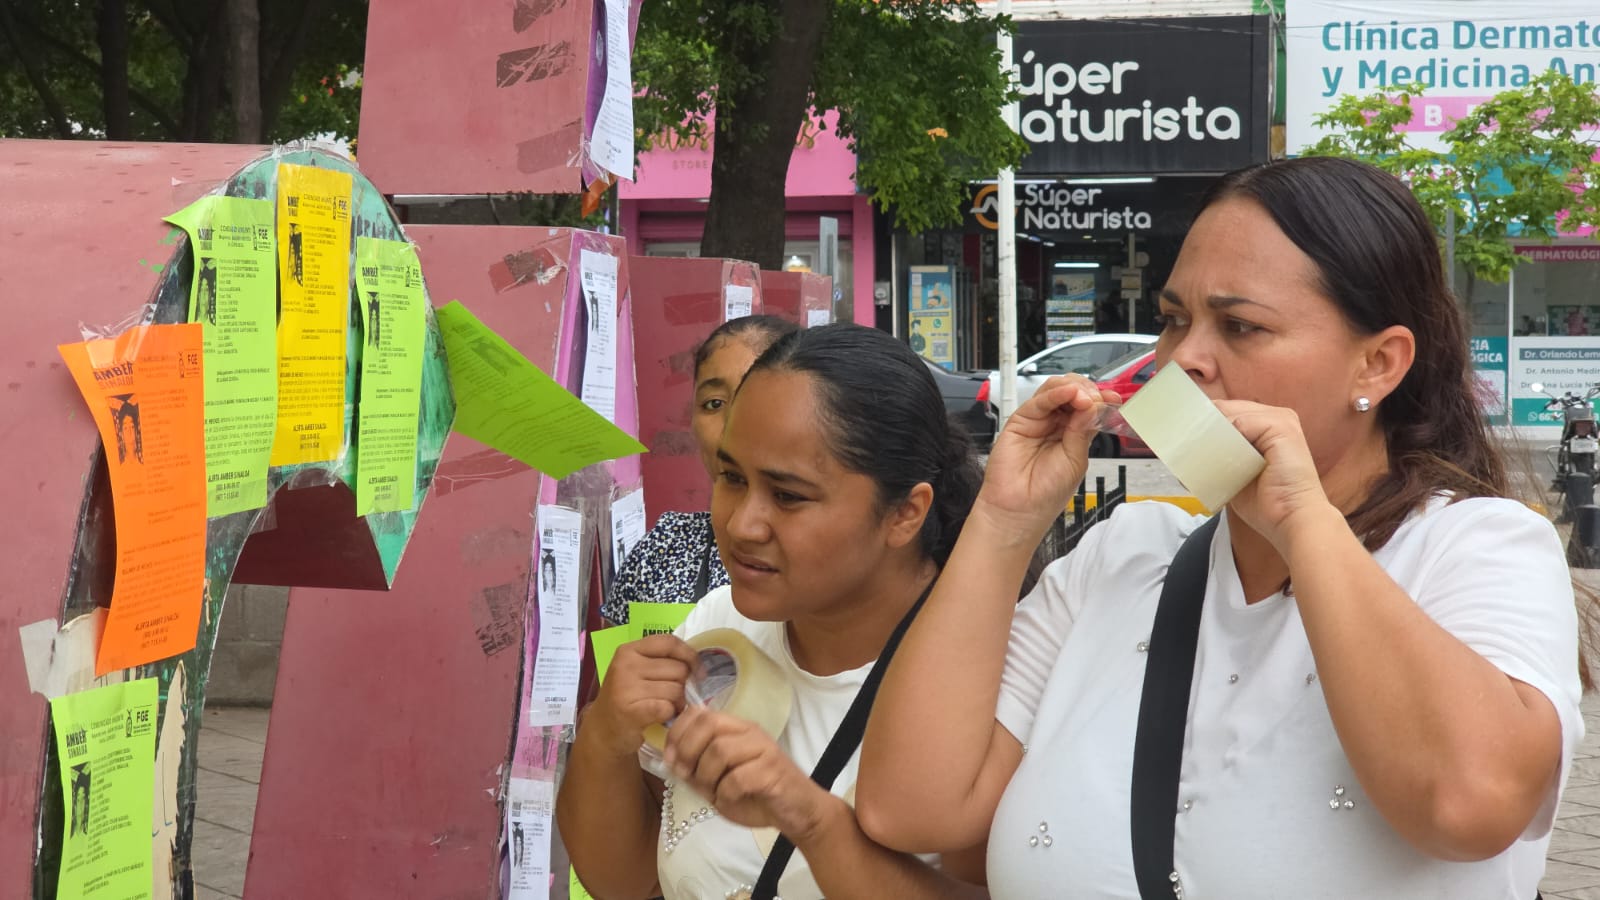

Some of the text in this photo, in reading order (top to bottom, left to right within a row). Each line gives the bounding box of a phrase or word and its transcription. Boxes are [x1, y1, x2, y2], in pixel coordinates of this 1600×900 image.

[1322, 20, 1439, 51] Clínica
[1011, 50, 1140, 106] úper
[1321, 57, 1600, 97] y Medicina An
[1012, 96, 1241, 143] aturista
[672, 160, 709, 170] STORE
[1024, 183, 1102, 211] Súper
[1024, 206, 1151, 230] Naturista
[1524, 350, 1600, 359] Dr. Orlando Lem
[93, 361, 134, 382] AMBER
[1540, 367, 1574, 375] Antonio
[136, 709, 149, 723] FGE
[65, 728, 87, 748] AMBER
[67, 743, 88, 759] SINALOA
